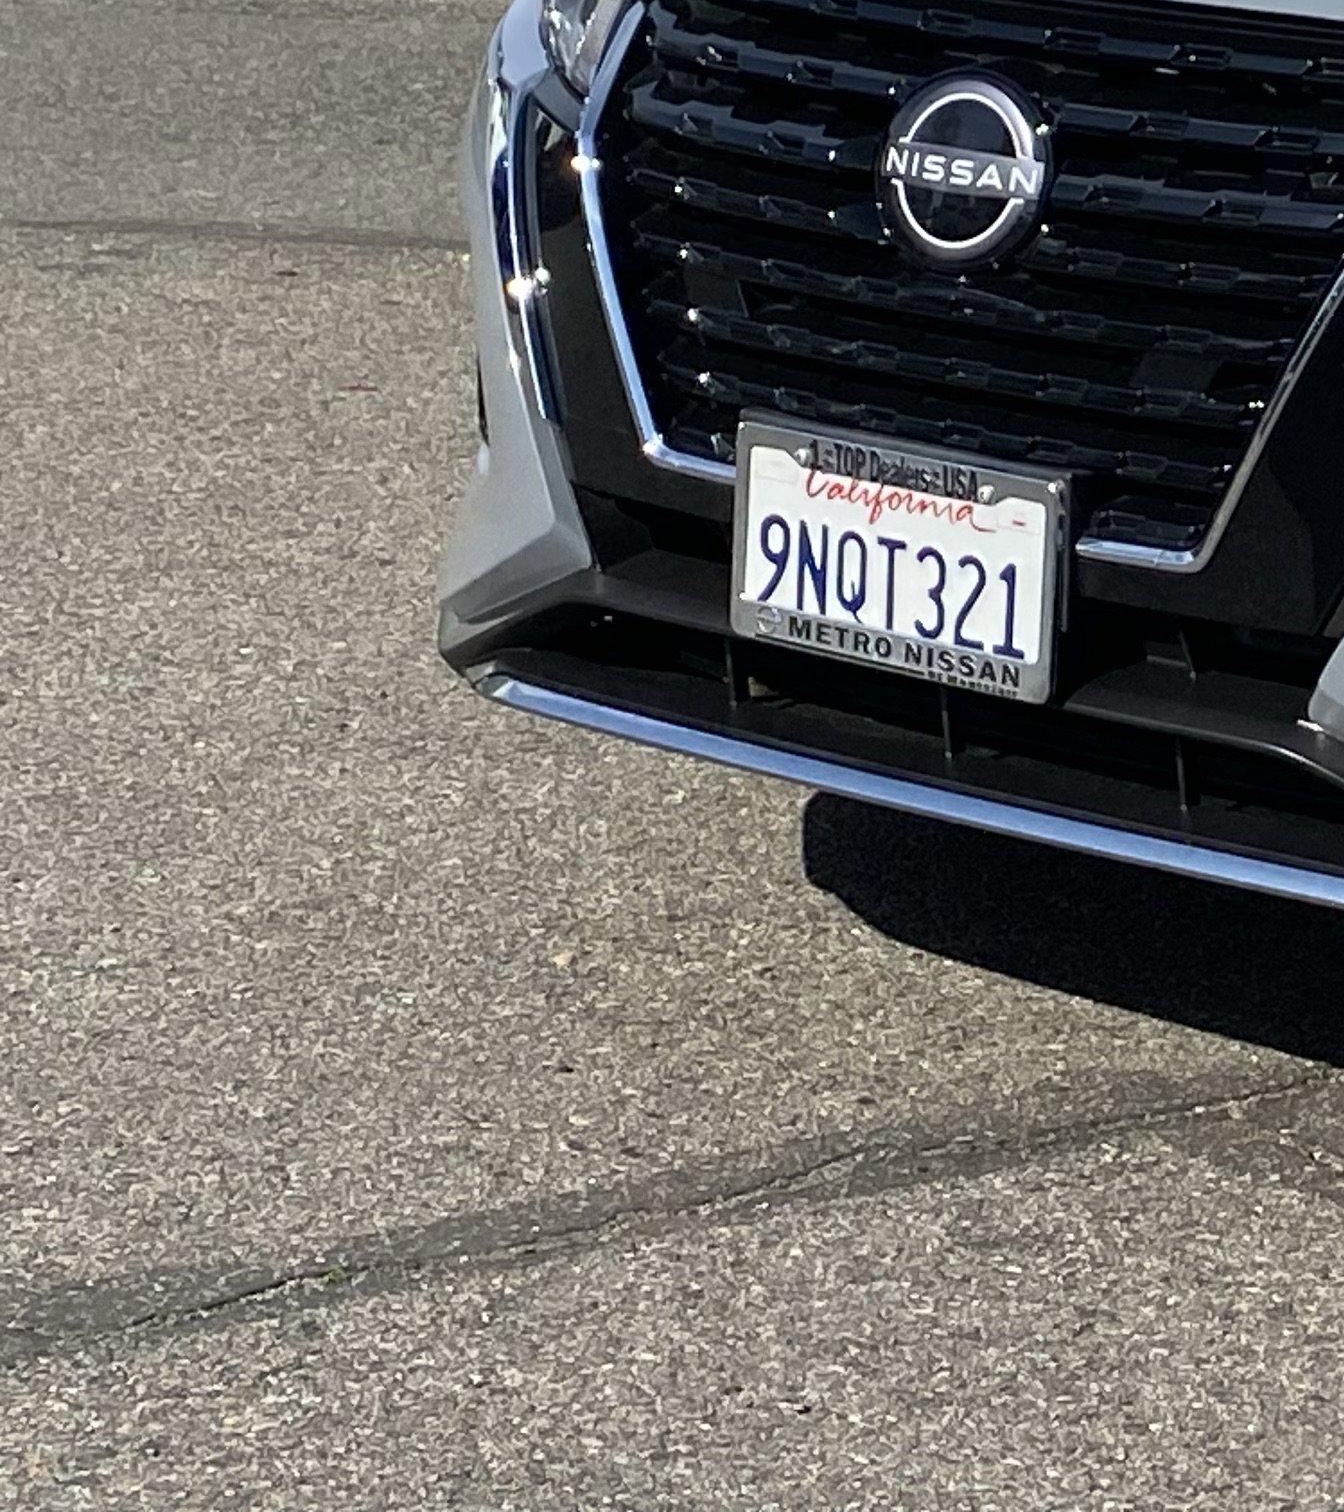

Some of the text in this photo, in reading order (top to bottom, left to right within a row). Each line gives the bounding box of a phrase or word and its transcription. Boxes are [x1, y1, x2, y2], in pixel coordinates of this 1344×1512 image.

[886, 145, 1039, 194] NISSAN
[804, 463, 996, 533] California
[942, 464, 979, 502] USA
[756, 512, 1026, 660] 9NQT321
[788, 614, 893, 658] METRO
[904, 639, 1022, 689] NISSAN
